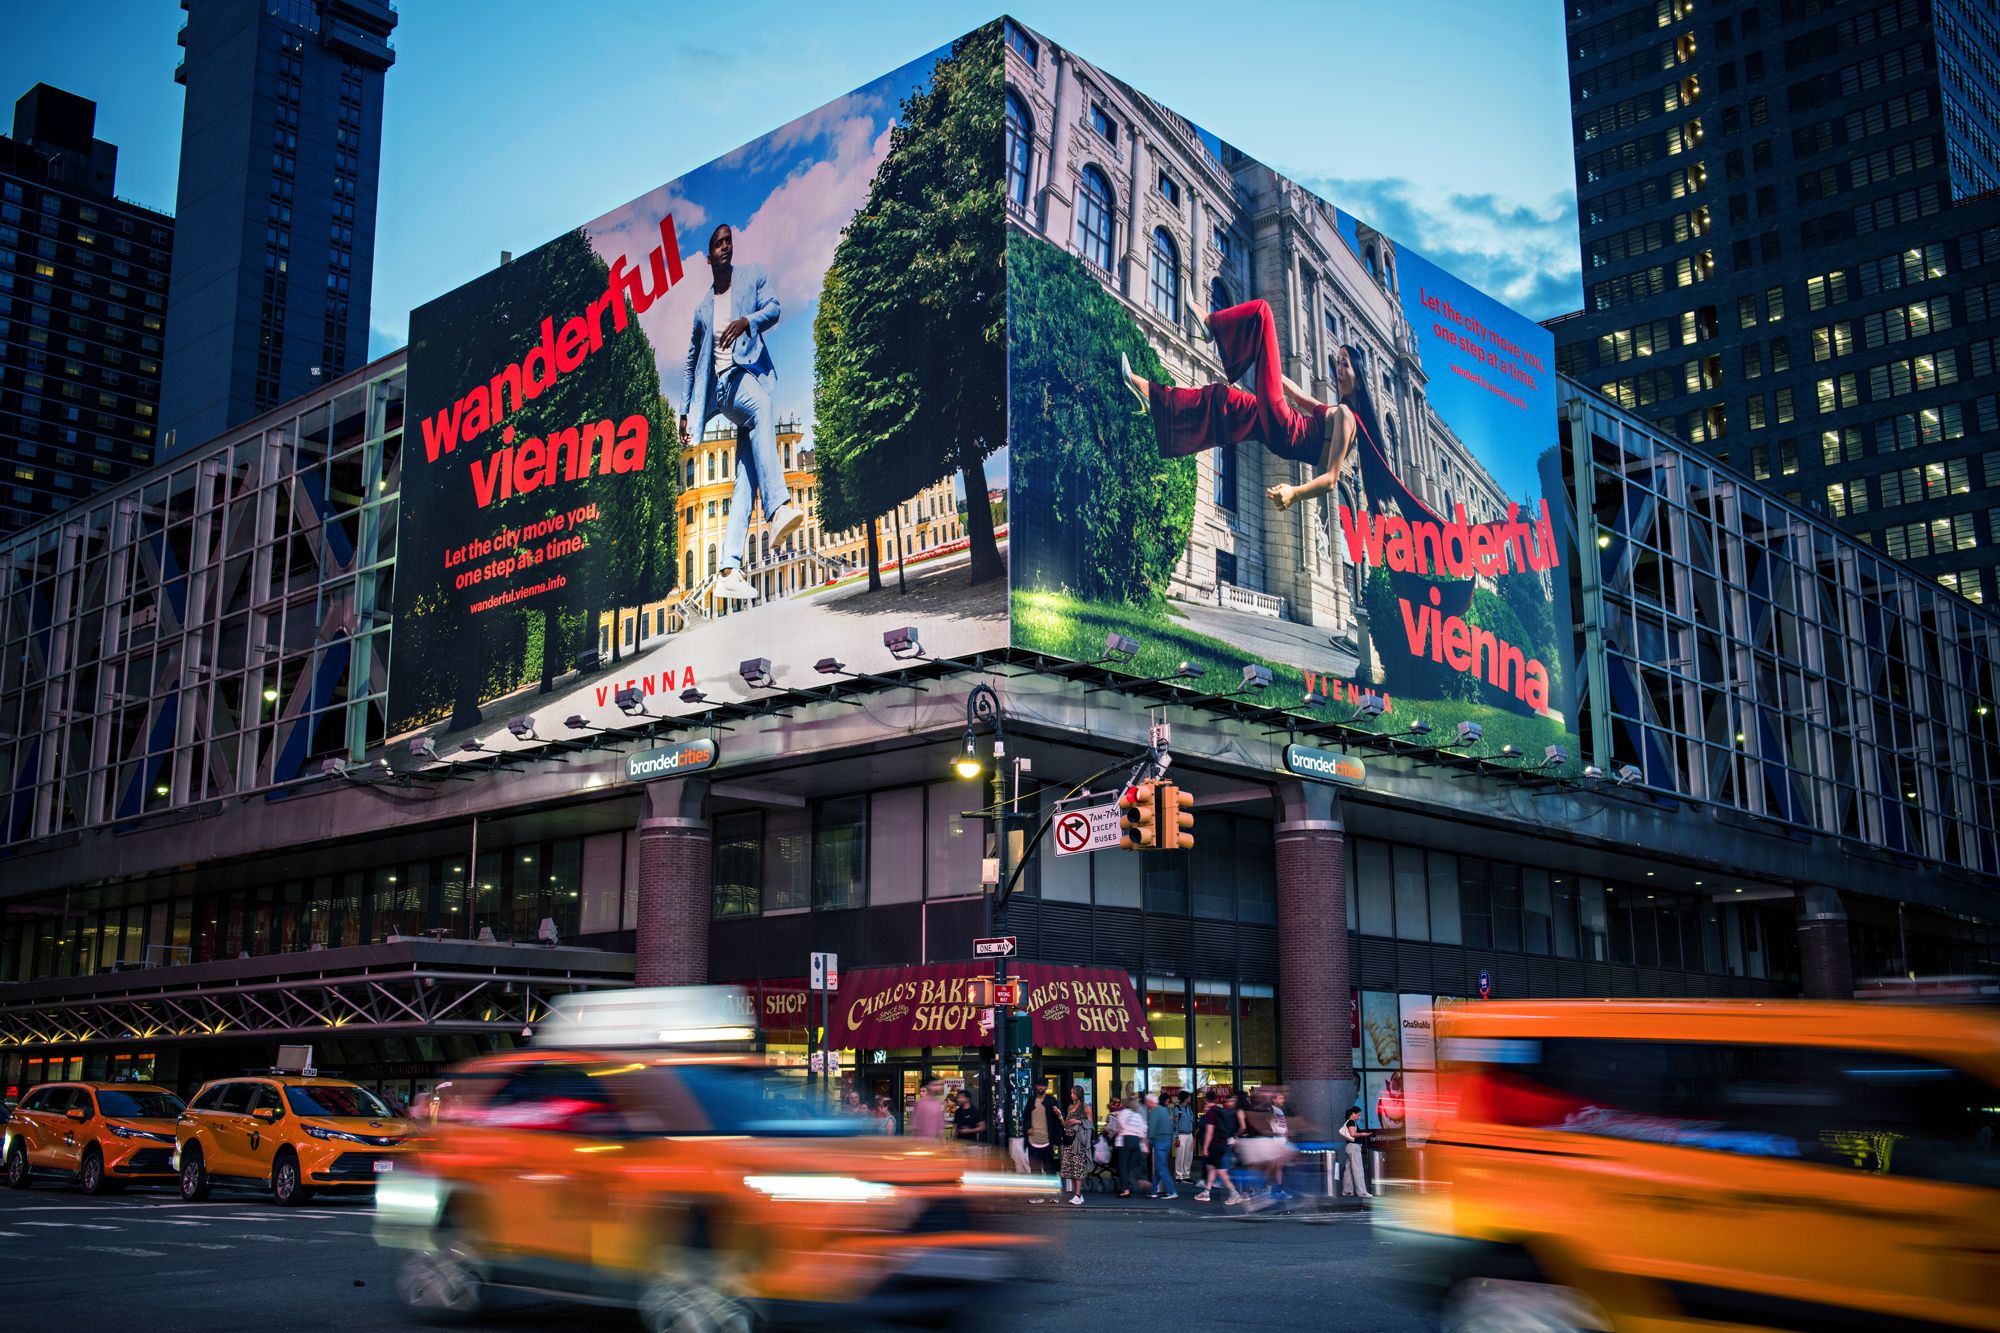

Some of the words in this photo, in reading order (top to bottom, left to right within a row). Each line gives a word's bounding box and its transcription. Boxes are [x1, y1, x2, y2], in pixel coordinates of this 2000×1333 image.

[421, 213, 684, 464] wanderful
[1420, 287, 1441, 314] Let
[1442, 300, 1463, 326] the
[1465, 314, 1487, 342] city
[1489, 330, 1521, 359] move
[1433, 323, 1457, 347] one
[1459, 336, 1486, 363] step
[1487, 351, 1499, 369] at
[1500, 360, 1508, 374] a
[1510, 361, 1537, 390] time.
[1450, 363, 1528, 411] wanderful.vienna.info
[470, 414, 649, 509] vienna
[444, 546, 467, 568] Let
[468, 537, 492, 562] the
[493, 528, 521, 551] city
[522, 514, 565, 542] move
[567, 502, 601, 531] you,
[1338, 498, 1560, 578] wanderful
[455, 568, 483, 590] one
[484, 556, 516, 581] step
[517, 549, 533, 571] at
[534, 547, 544, 565] a
[546, 535, 586, 561] time.
[470, 574, 567, 614] wanderful.vienna.info
[1399, 586, 1550, 715] vienna
[630, 747, 711, 776] brandedcities
[1292, 750, 1363, 780] brandedcities
[1089, 810, 1119, 822] 7AM-7PM
[1092, 822, 1117, 832] EXCEPT
[1094, 833, 1117, 843] BUSES
[979, 944, 993, 952] ONE
[997, 943, 1010, 951] WAY
[765, 992, 807, 1014] SHOP
[920, 978, 966, 1004] BAK
[1027, 981, 1069, 1013] ARLO'S
[1071, 980, 1125, 1007] BAKE
[911, 1005, 977, 1031] SHOP
[1077, 1007, 1130, 1032] SHOP
